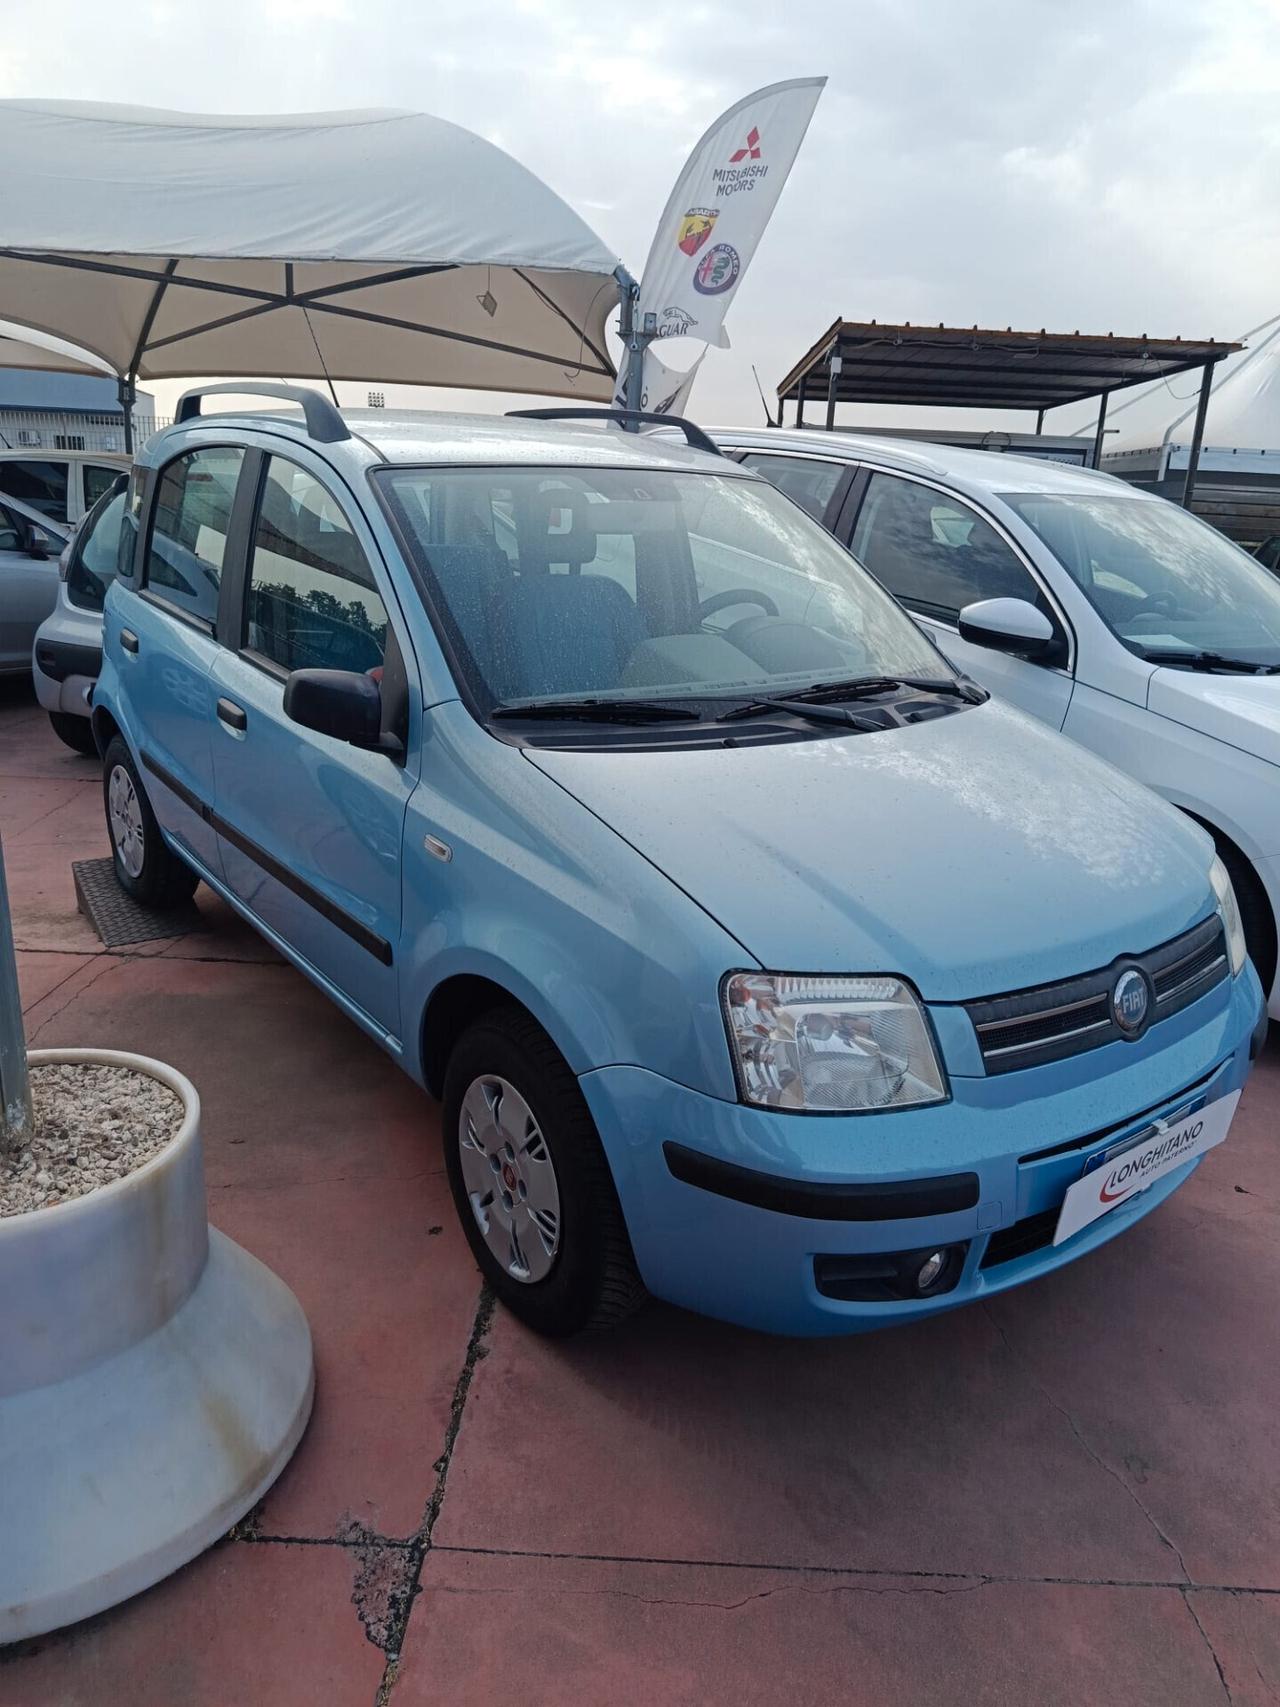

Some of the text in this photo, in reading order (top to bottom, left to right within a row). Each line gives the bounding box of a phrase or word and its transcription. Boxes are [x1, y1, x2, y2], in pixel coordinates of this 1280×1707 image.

[716, 179, 756, 197] MOORS
[657, 322, 690, 338] GUAR
[1122, 987, 1145, 1014] FIAT
[1110, 1121, 1204, 1188] LONGHITANO
